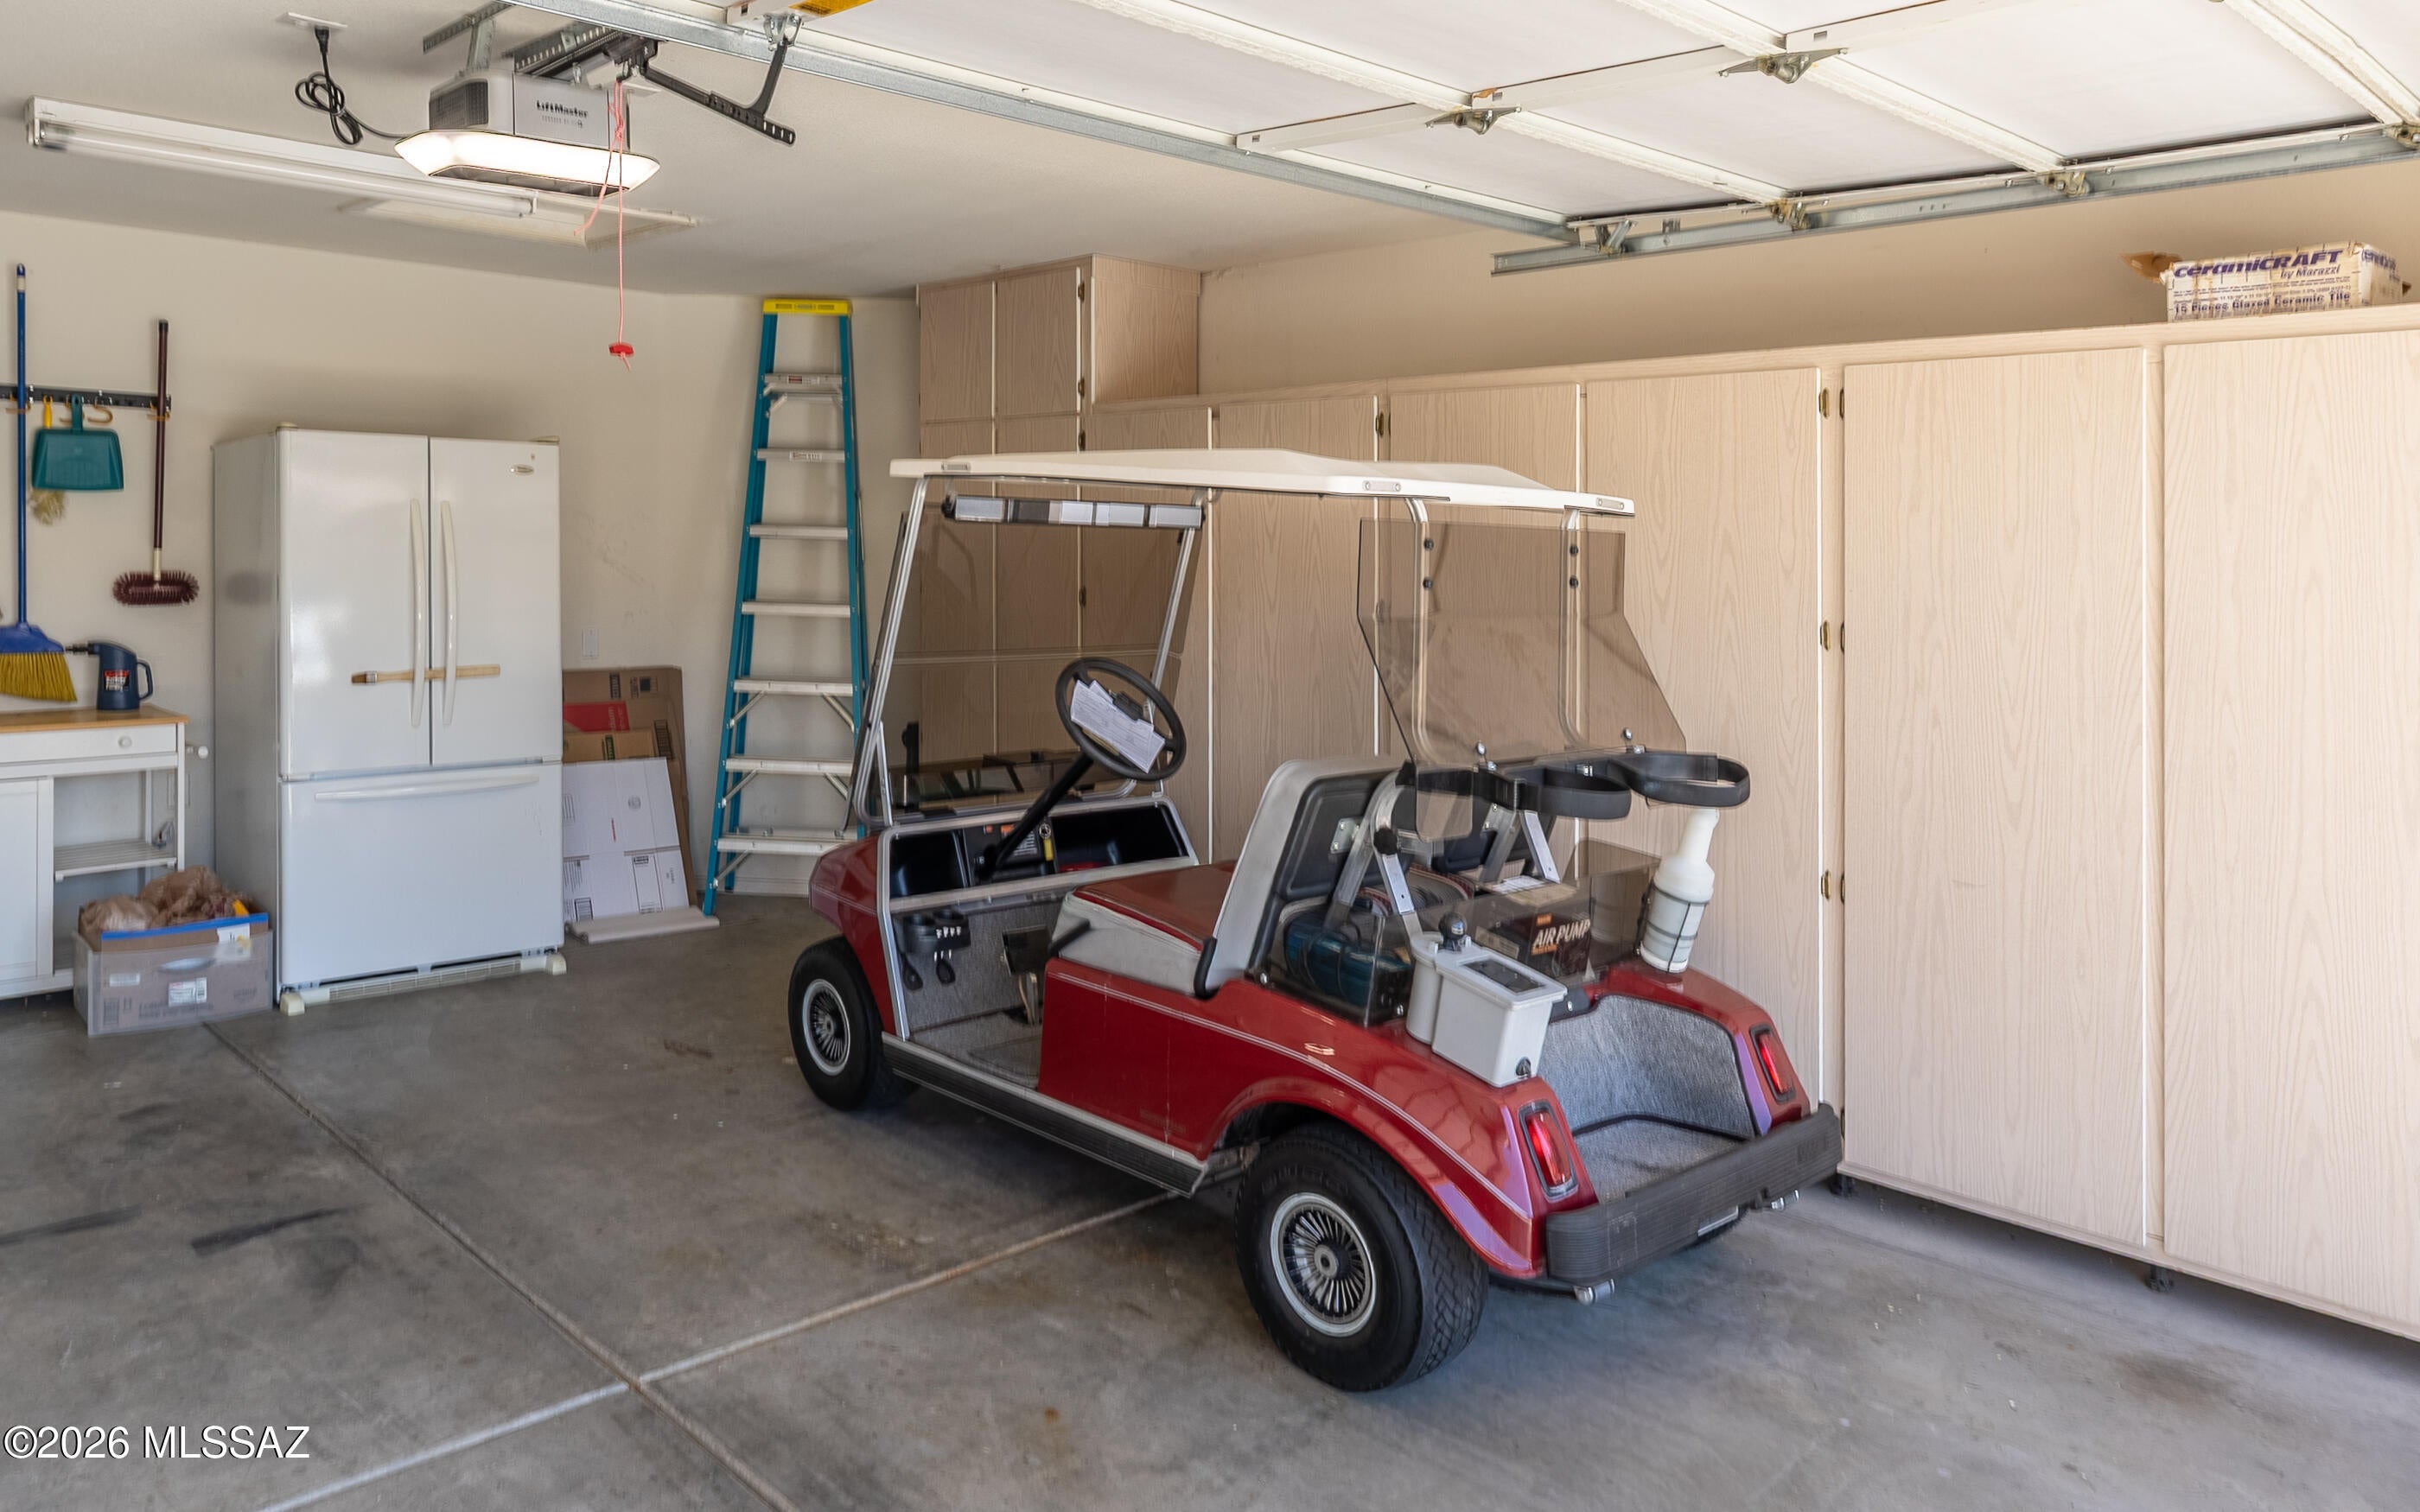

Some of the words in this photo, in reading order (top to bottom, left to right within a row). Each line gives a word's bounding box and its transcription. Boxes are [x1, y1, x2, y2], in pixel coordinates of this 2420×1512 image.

[536, 100, 588, 118] LiftMaster
[2280, 268, 2293, 279] by
[2296, 264, 2340, 277] Marazzi
[2192, 302, 2229, 312] Pieces
[2232, 298, 2270, 309] Glazed
[2274, 293, 2325, 307] Ceramic
[2329, 290, 2351, 302] Tile
[1532, 926, 1557, 950] AIR
[1556, 918, 1591, 944] PUMP
